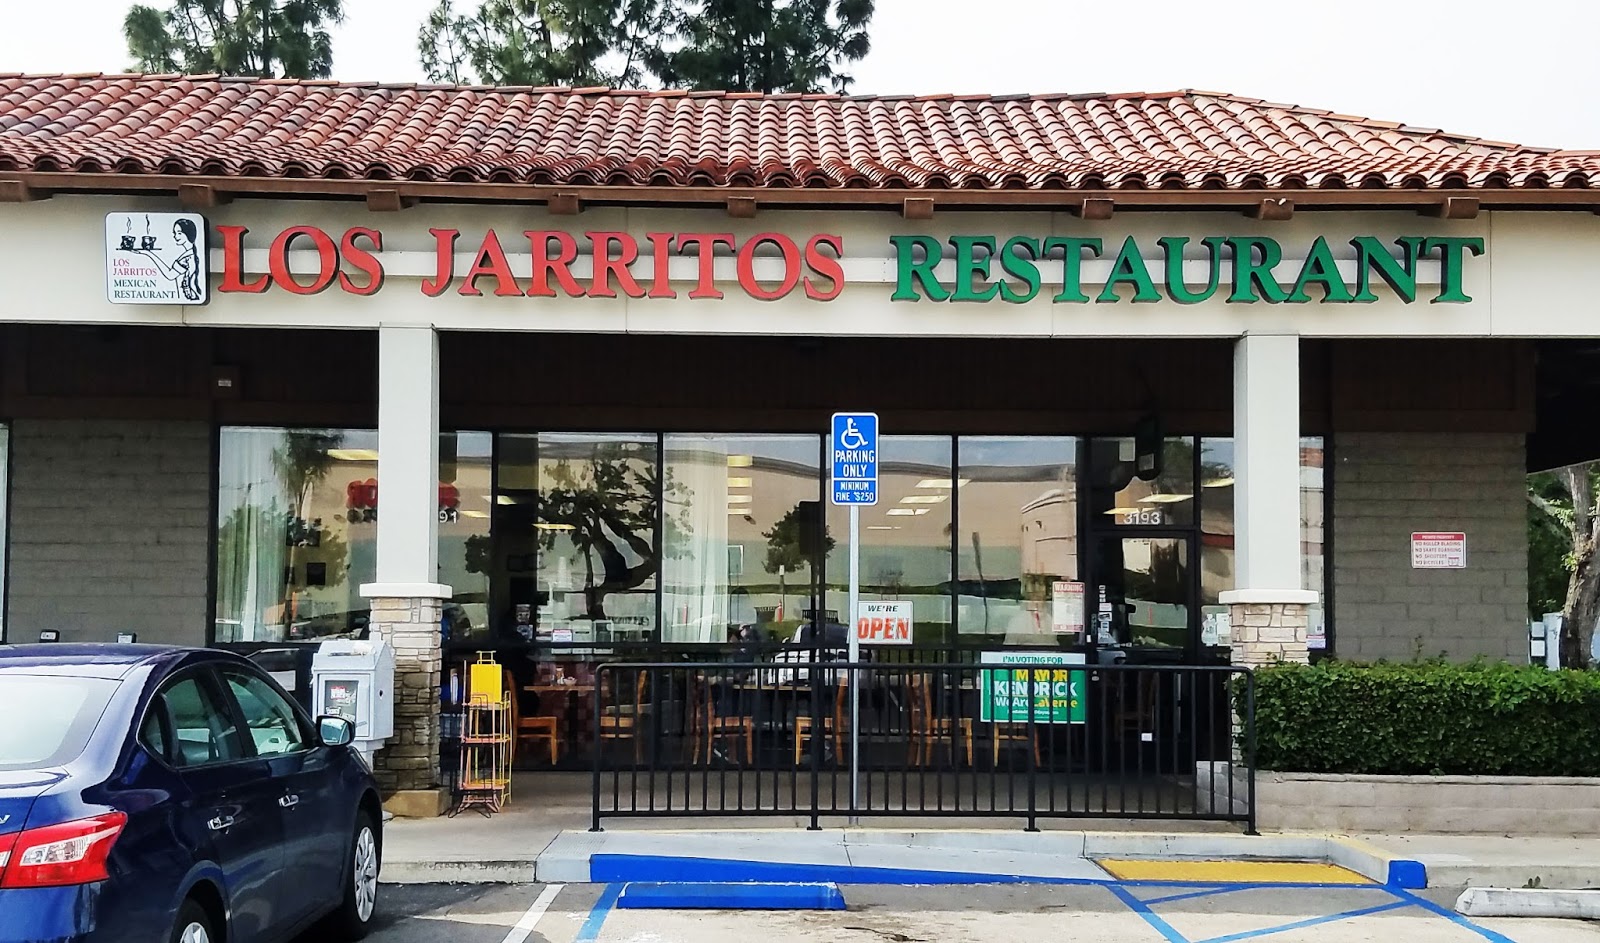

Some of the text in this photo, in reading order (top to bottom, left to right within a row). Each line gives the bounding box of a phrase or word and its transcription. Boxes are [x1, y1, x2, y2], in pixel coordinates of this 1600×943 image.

[113, 259, 130, 267] LOS
[216, 224, 1485, 305] LOS JARRITOS RESTAURANT
[113, 268, 158, 276] JARRITOS
[113, 279, 157, 288] MEXICAN
[114, 290, 176, 299] RESTAURANT
[835, 450, 875, 463] PARKING
[843, 464, 867, 477] ONLY
[840, 482, 870, 491] MINIMUM
[835, 492, 874, 502] FINE $250
[1123, 511, 1161, 525] 3193
[857, 617, 910, 639] OPEN
[1002, 655, 1063, 665] I'M VOTING FOR
